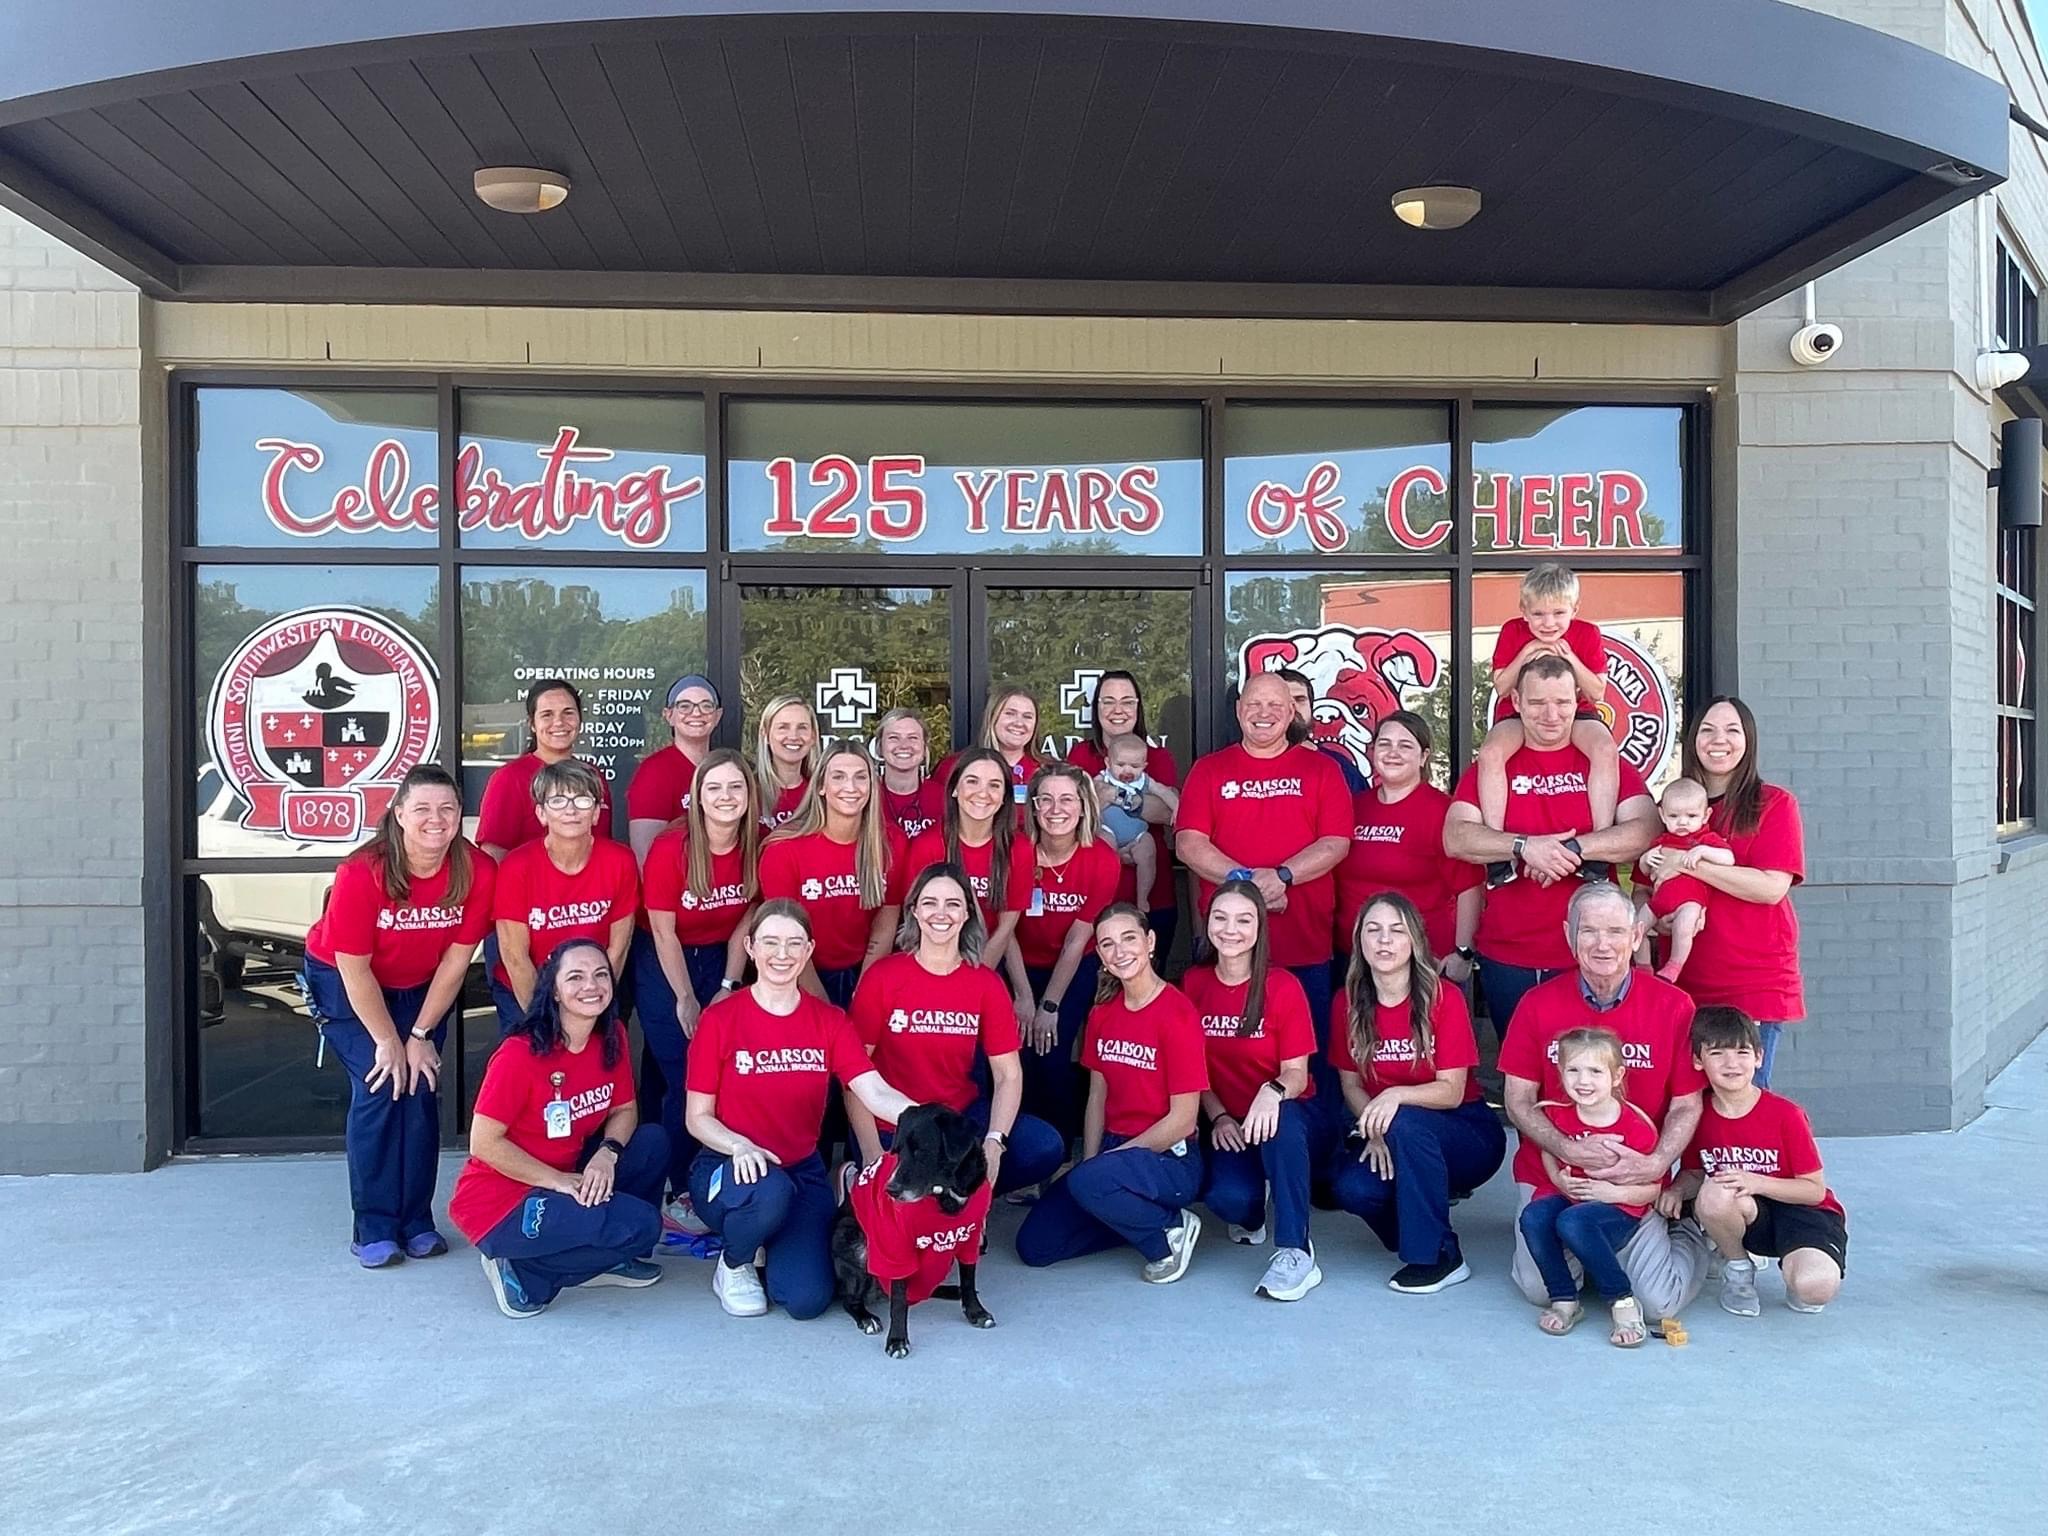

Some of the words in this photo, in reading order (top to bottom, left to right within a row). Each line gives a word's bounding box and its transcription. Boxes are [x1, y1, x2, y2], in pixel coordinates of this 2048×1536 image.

[255, 426, 702, 547] Celebrating
[764, 454, 927, 539] 125
[953, 466, 1164, 536] YEARS
[1384, 465, 1649, 550] CHEER
[226, 618, 343, 706] SOUTHWESTERN
[350, 621, 423, 699] LOUISIANA
[513, 667, 600, 680] OPERATING
[603, 667, 656, 680] HOURS
[598, 689, 653, 701] FRIDAY
[225, 721, 262, 784] INDUST
[390, 715, 428, 781] STITUTE
[1242, 778, 1301, 792] CARSON
[1532, 772, 1585, 789] CARSON
[295, 800, 351, 828] 1898
[1354, 825, 1405, 837] CARSON
[548, 900, 612, 921] CARSON
[912, 1009, 980, 1027] CARSON
[909, 1025, 941, 1034] ANIMAL
[755, 1048, 825, 1065] CARSON
[1104, 1039, 1157, 1061] CARSON
[755, 1063, 790, 1074] ANIMAL
[1624, 1059, 1654, 1069] PITAL
[1713, 1146, 1778, 1164] CARSON
